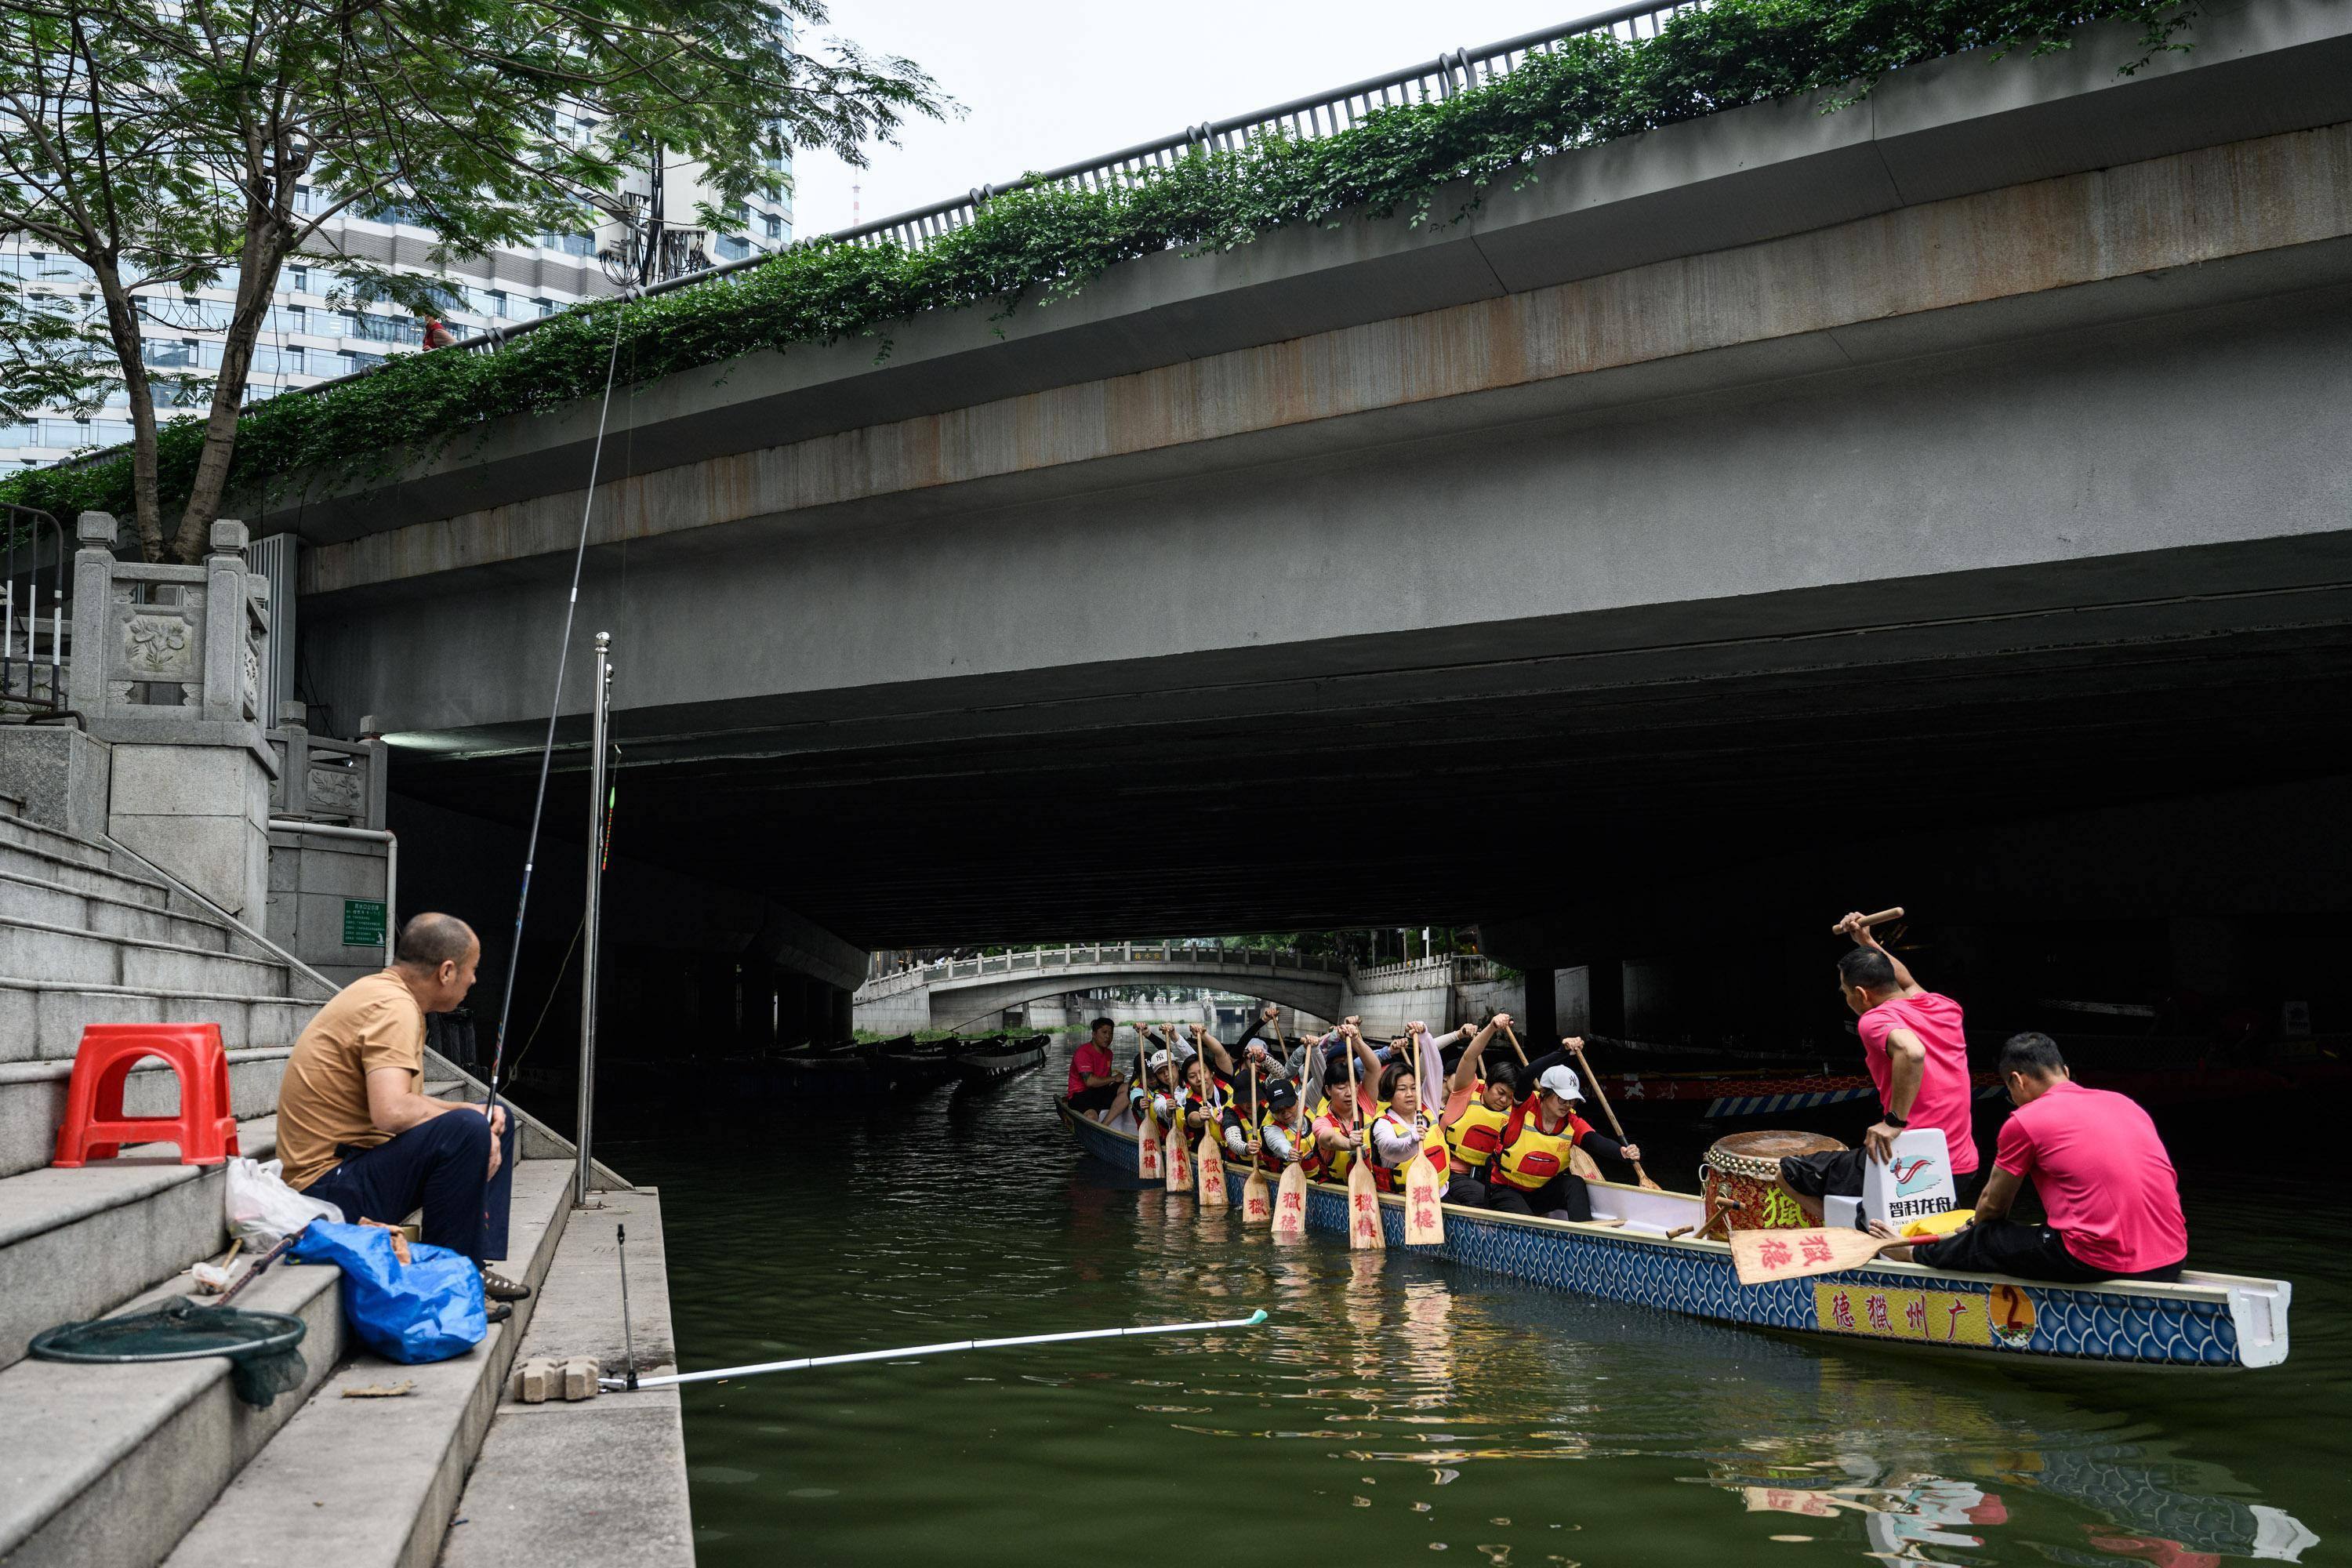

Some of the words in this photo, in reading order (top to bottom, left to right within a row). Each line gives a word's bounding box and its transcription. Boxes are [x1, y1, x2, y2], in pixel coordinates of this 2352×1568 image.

[1889, 1196, 1951, 1218] 智科龙舟
[2002, 1285, 2023, 1330] 2
